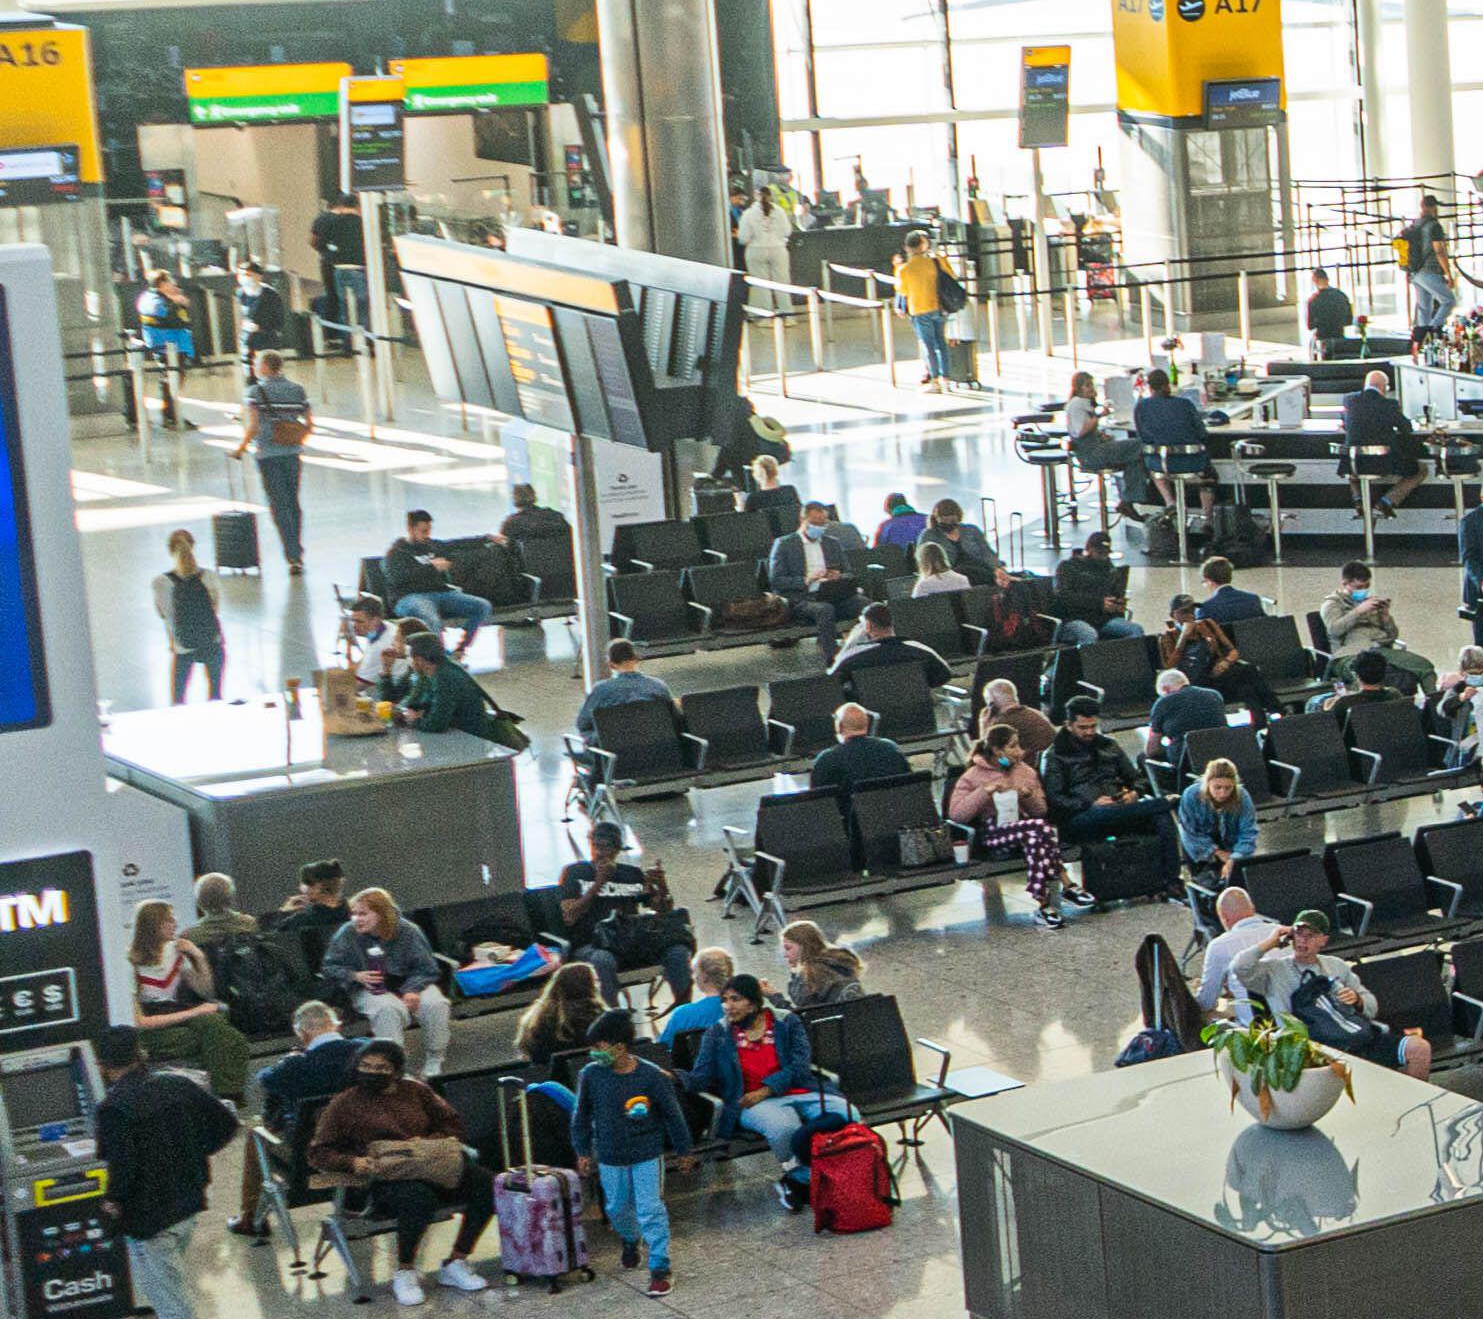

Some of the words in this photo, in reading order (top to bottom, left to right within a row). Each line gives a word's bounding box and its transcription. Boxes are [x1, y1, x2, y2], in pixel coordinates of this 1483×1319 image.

[1228, 87, 1259, 101] jetBlue
[0, 889, 70, 933] TM
[43, 1270, 112, 1300] Cash
